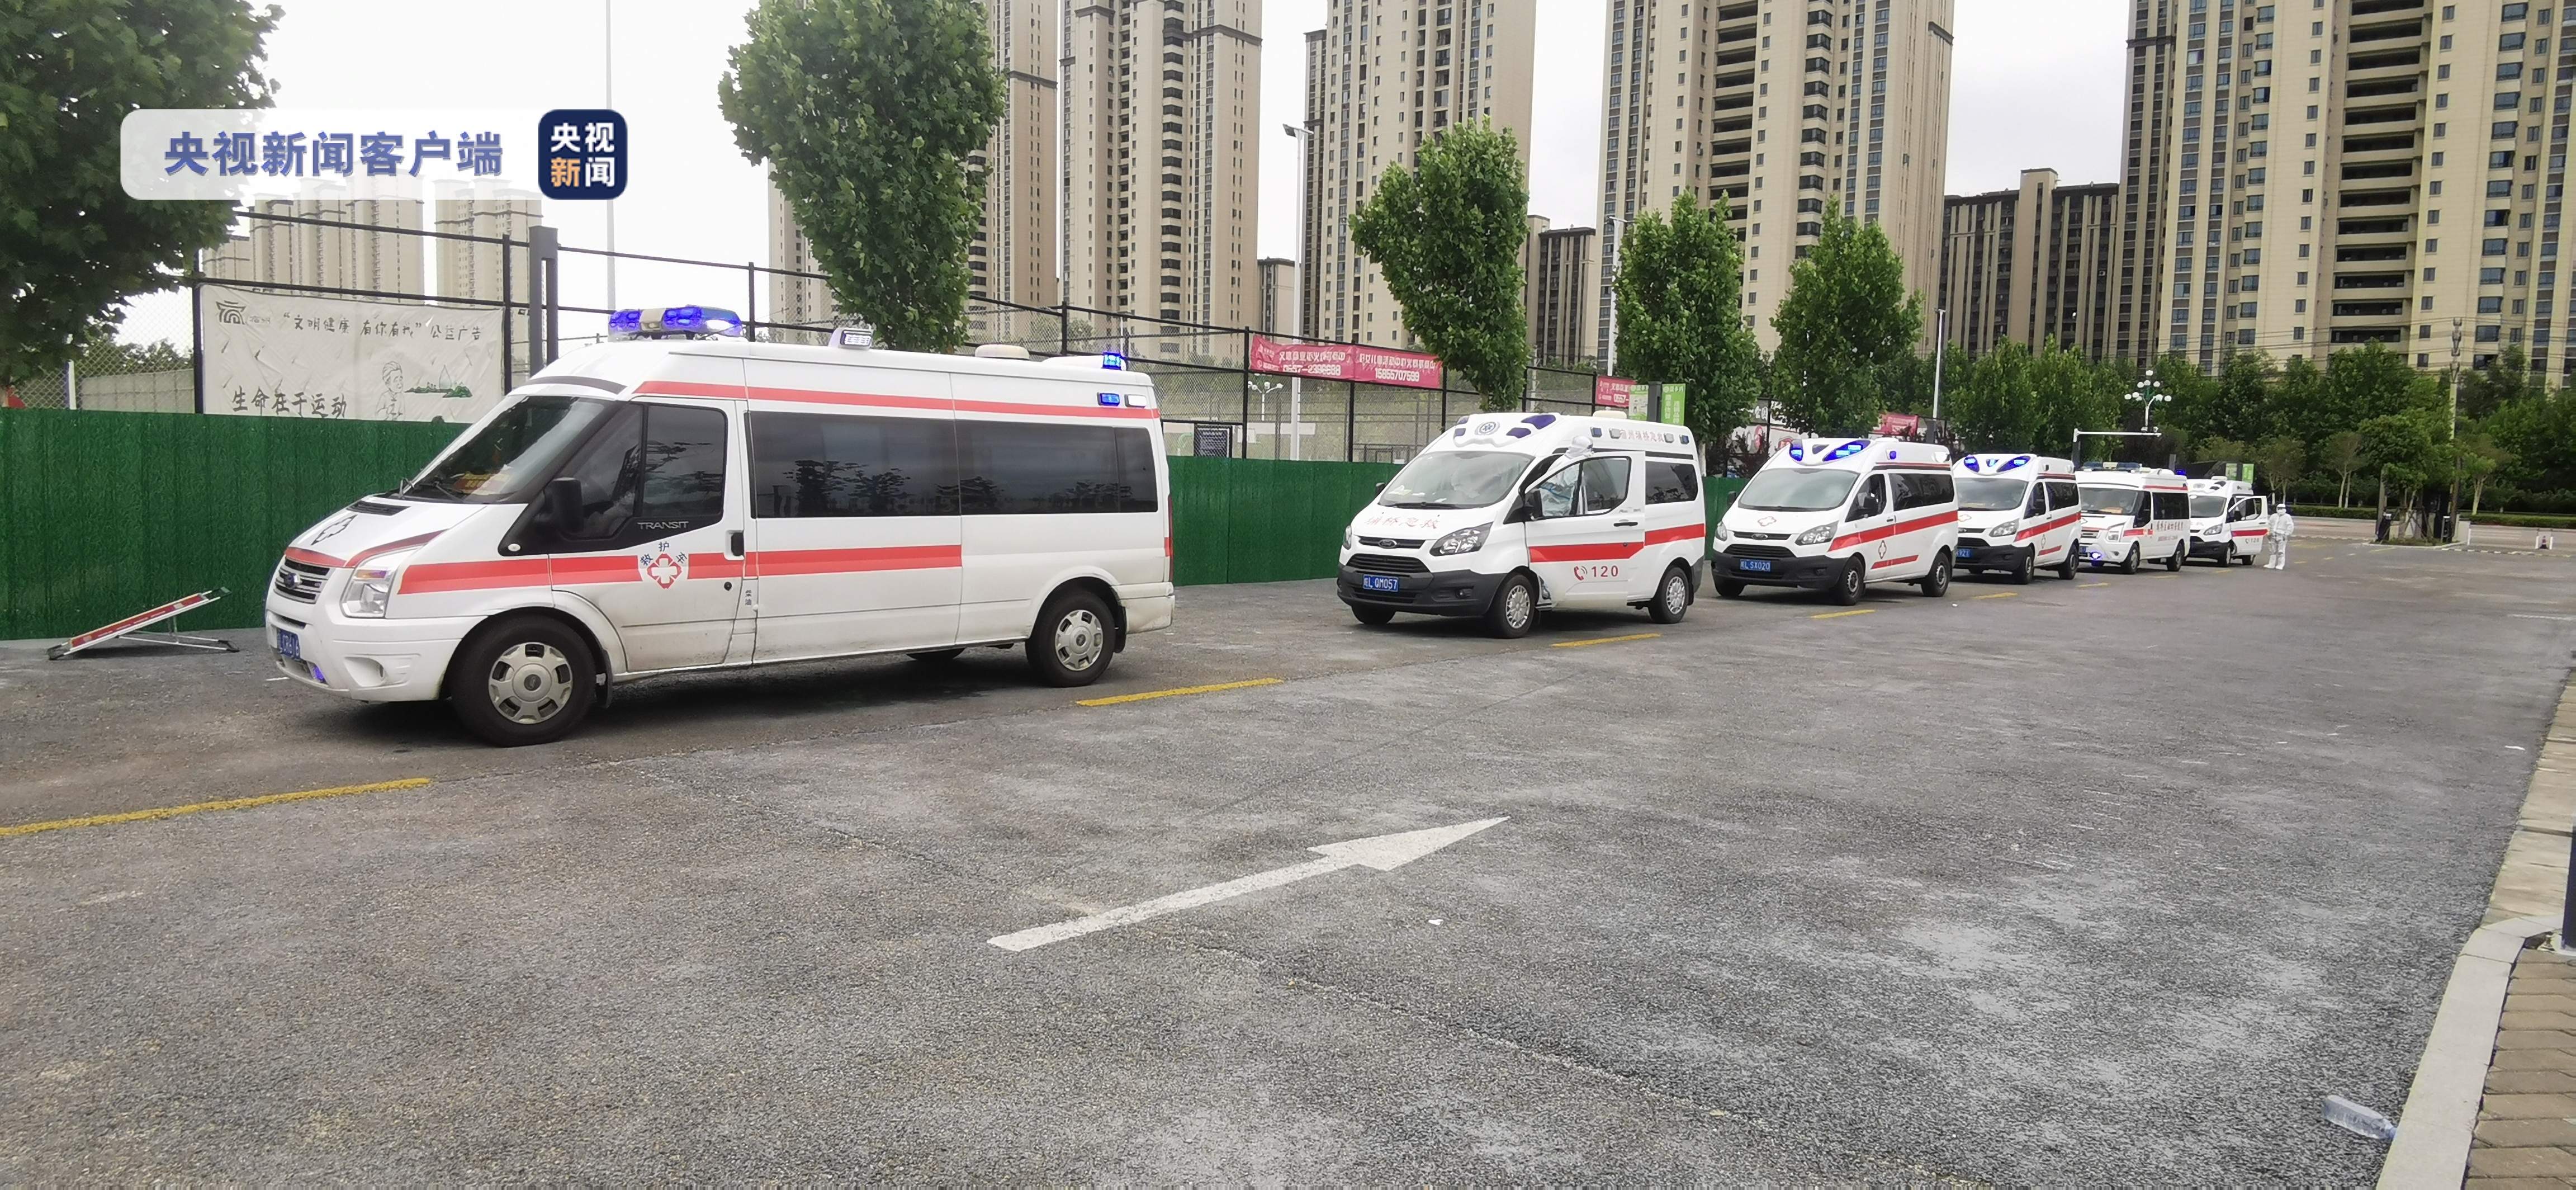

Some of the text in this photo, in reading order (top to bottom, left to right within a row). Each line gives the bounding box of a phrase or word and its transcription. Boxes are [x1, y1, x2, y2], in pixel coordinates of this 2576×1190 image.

[430, 324, 481, 341] 公益广告
[232, 385, 347, 418] 生命在于运动
[637, 521, 689, 530] TRANSIT
[640, 541, 688, 566] 救护车
[1591, 565, 1618, 578] 120
